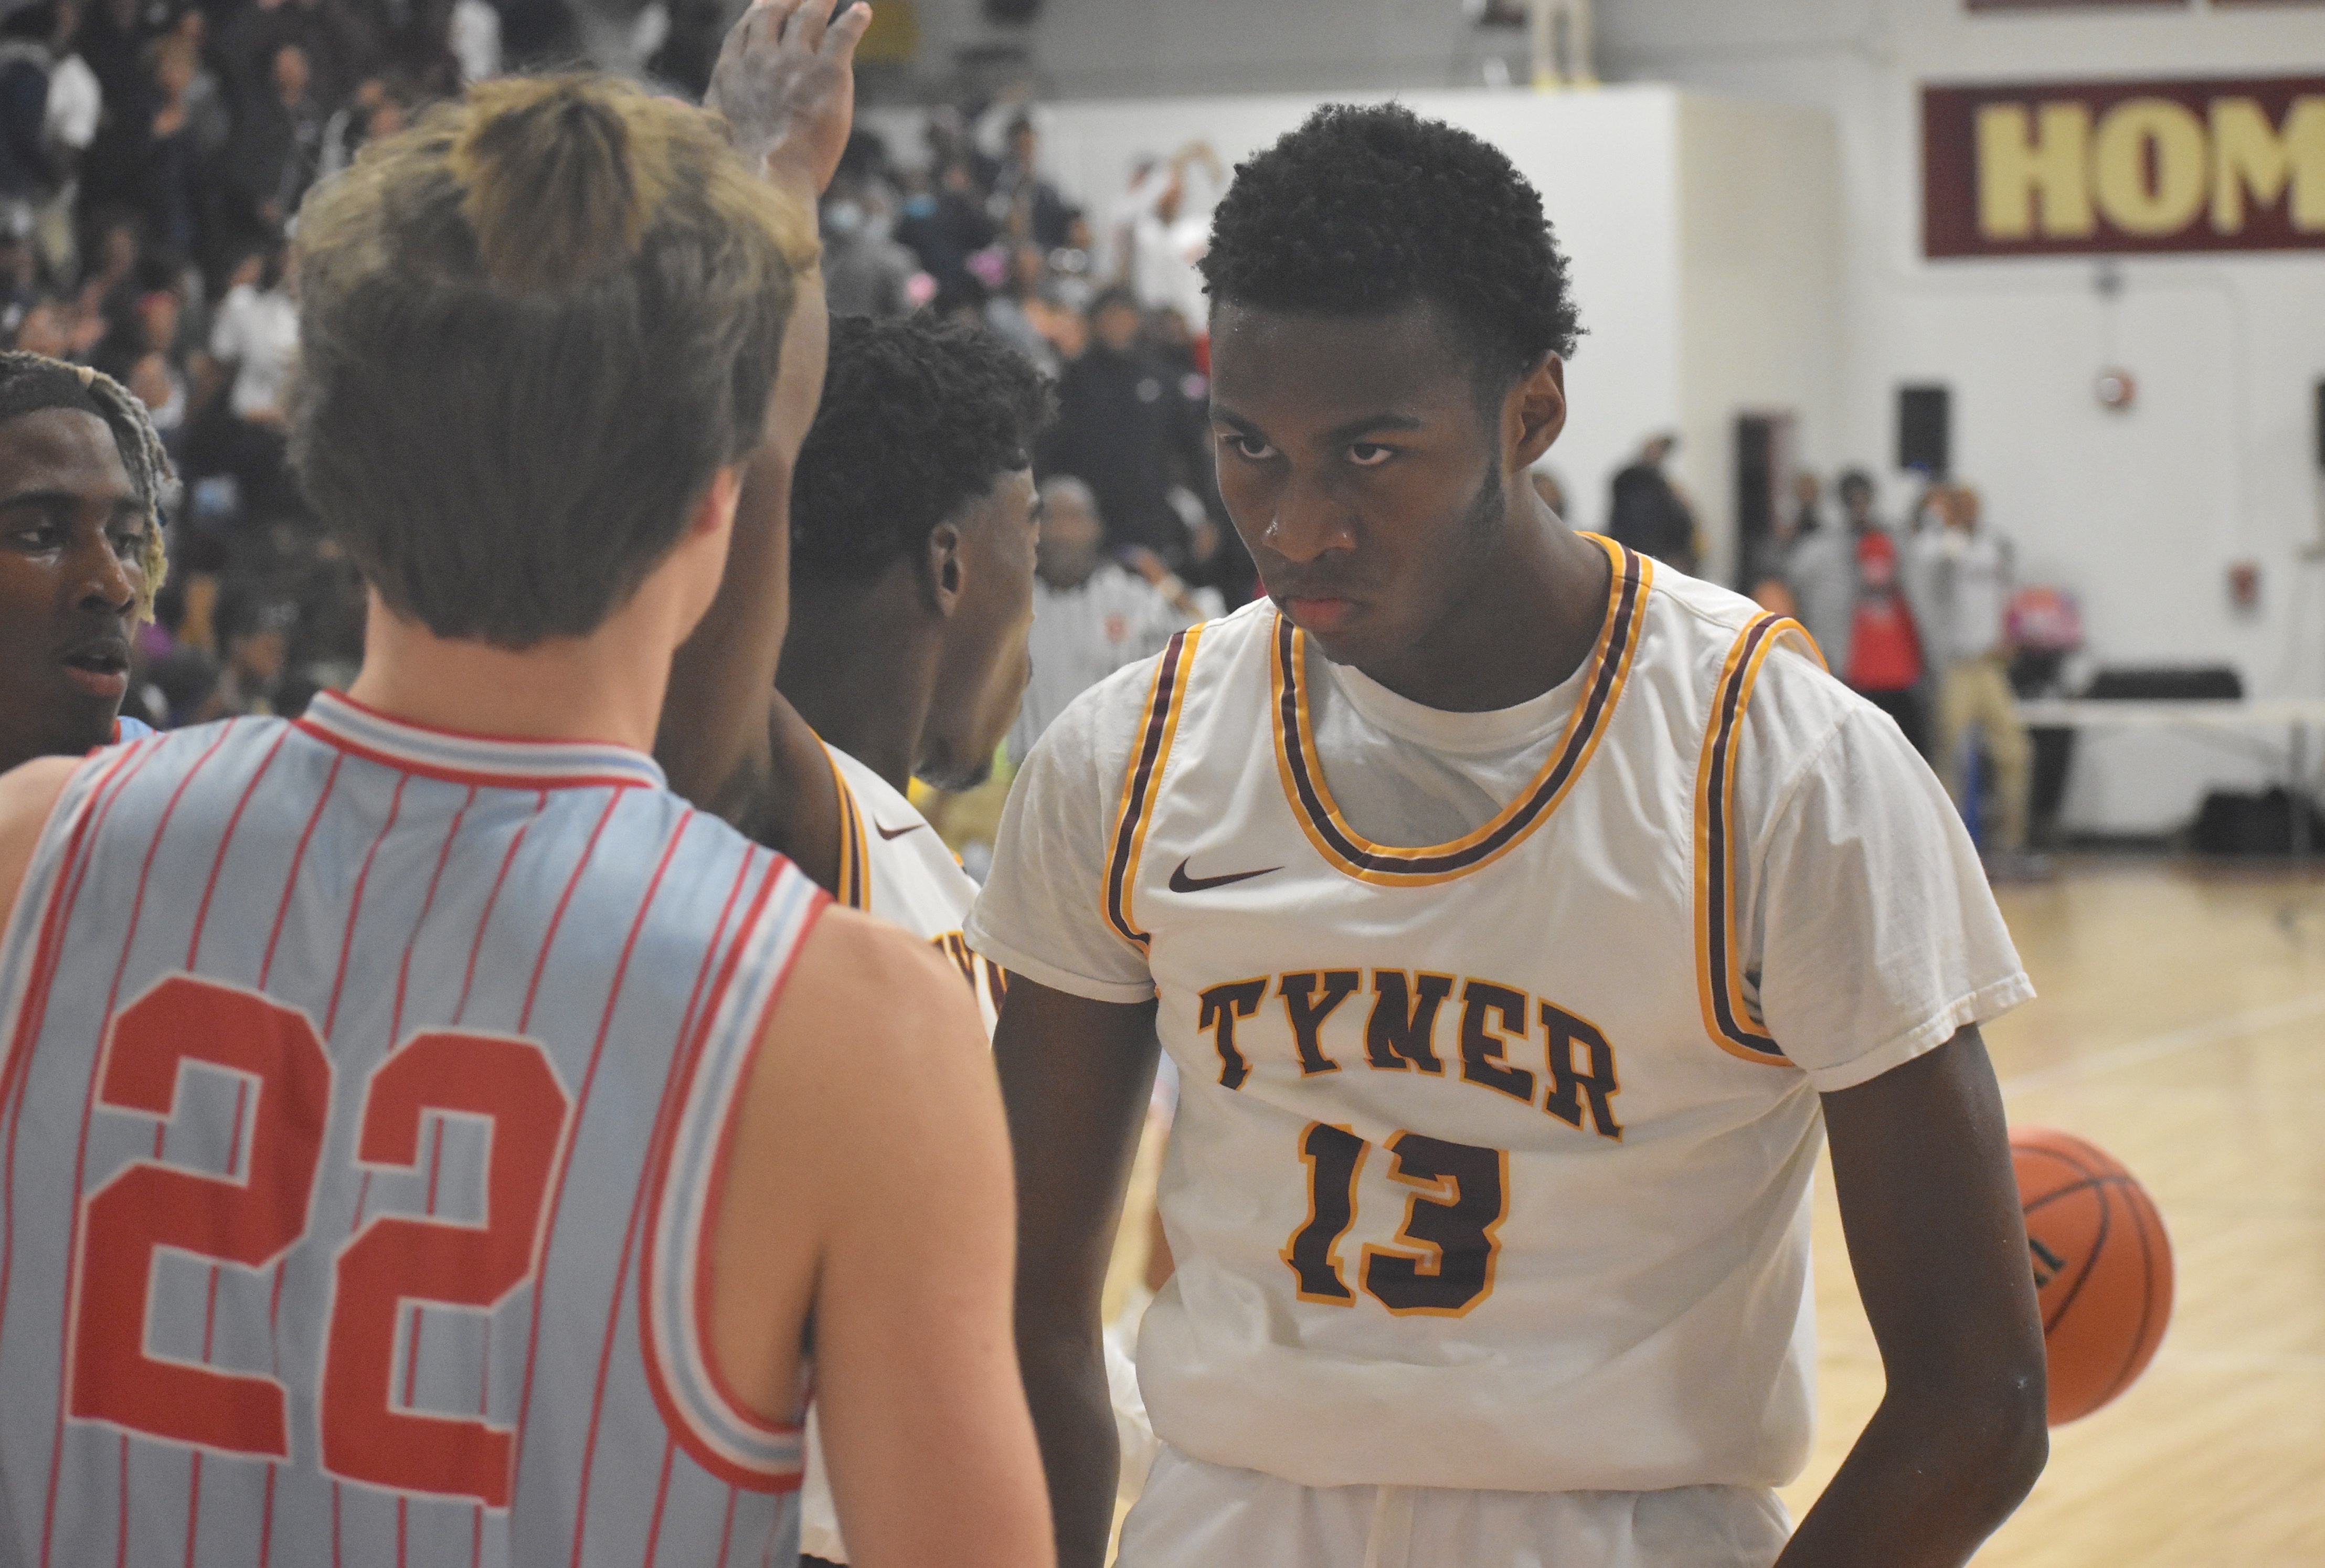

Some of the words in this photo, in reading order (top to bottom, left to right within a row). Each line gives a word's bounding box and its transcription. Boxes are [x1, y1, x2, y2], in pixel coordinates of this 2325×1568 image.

[1976, 96, 2325, 239] HOM
[1197, 967, 1623, 1142] TYNER
[65, 970, 575, 1516] 22
[1278, 1120, 1509, 1318] 13
